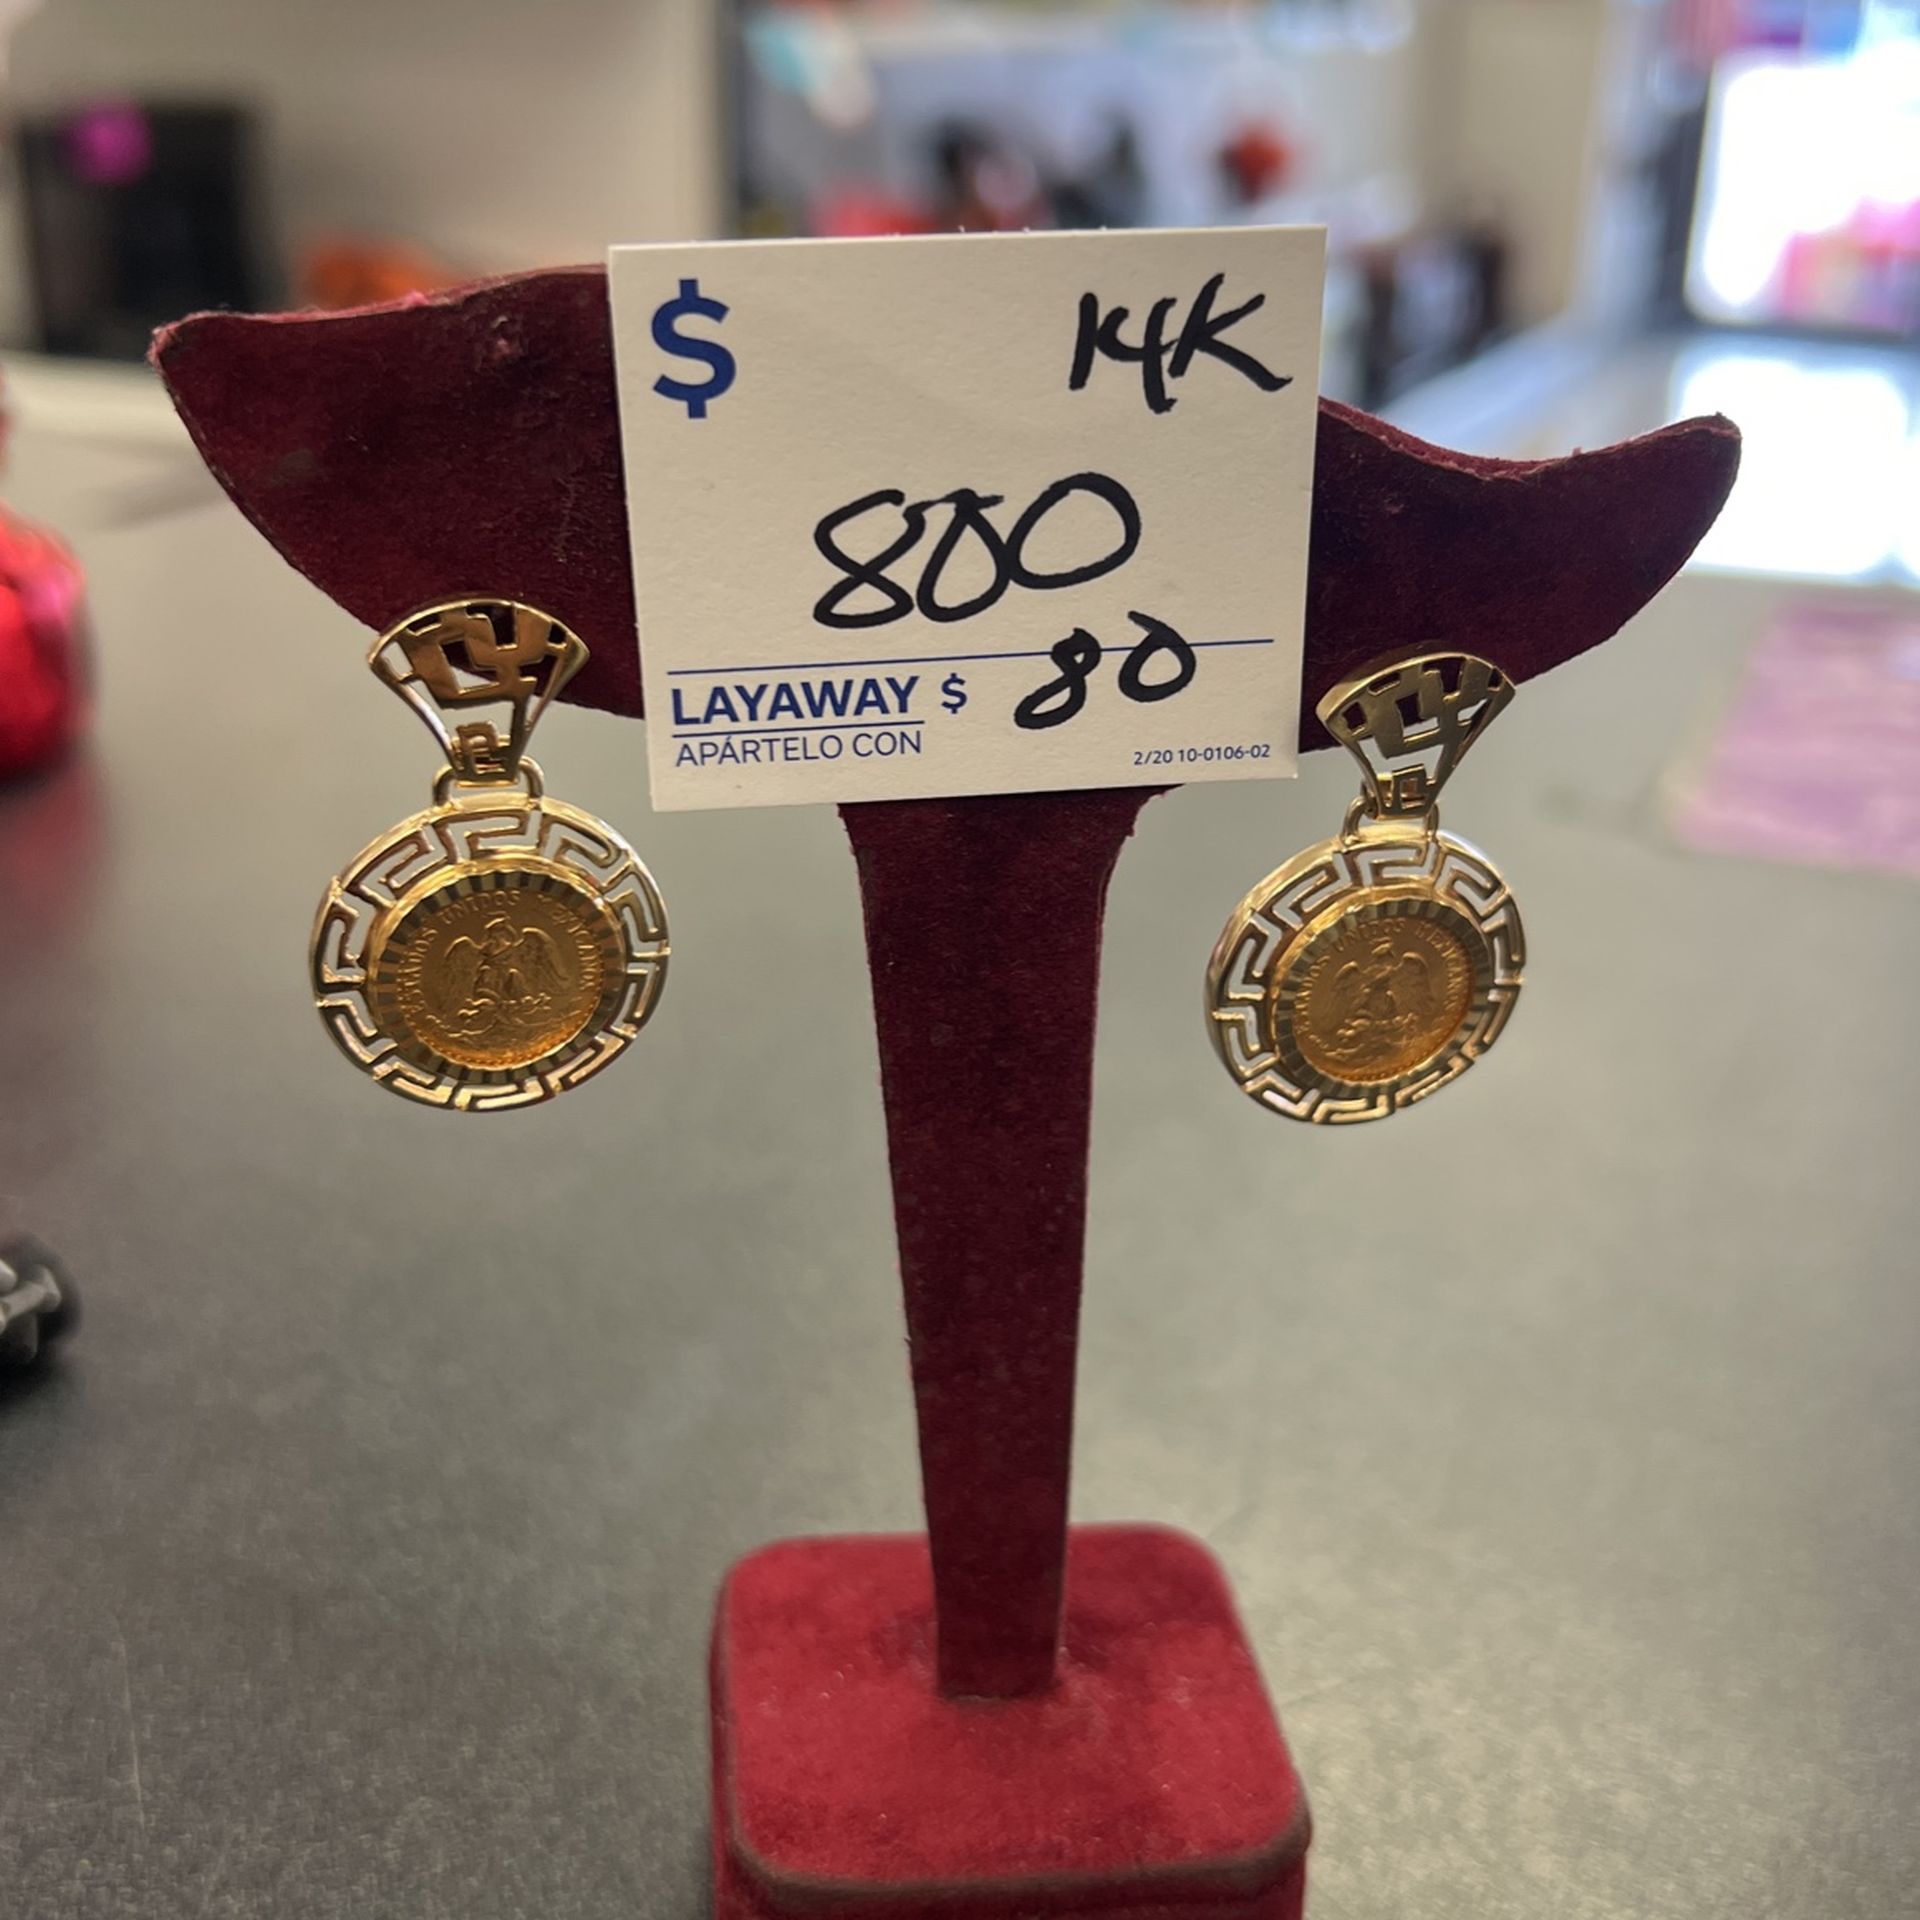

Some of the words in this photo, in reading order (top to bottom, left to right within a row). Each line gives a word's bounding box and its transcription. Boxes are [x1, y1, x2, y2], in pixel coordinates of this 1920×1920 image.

[651, 278, 738, 419] $
[1069, 272, 1293, 414] 14K
[813, 471, 1141, 628] 800
[671, 676, 920, 726] LAYAWAY
[940, 672, 968, 715] $
[1014, 610, 1196, 729] 80
[675, 734, 843, 767] APÁRTELO
[852, 730, 922, 757] CON
[1133, 750, 1173, 766] 2/20
[1178, 743, 1271, 763] 10-0106-02
